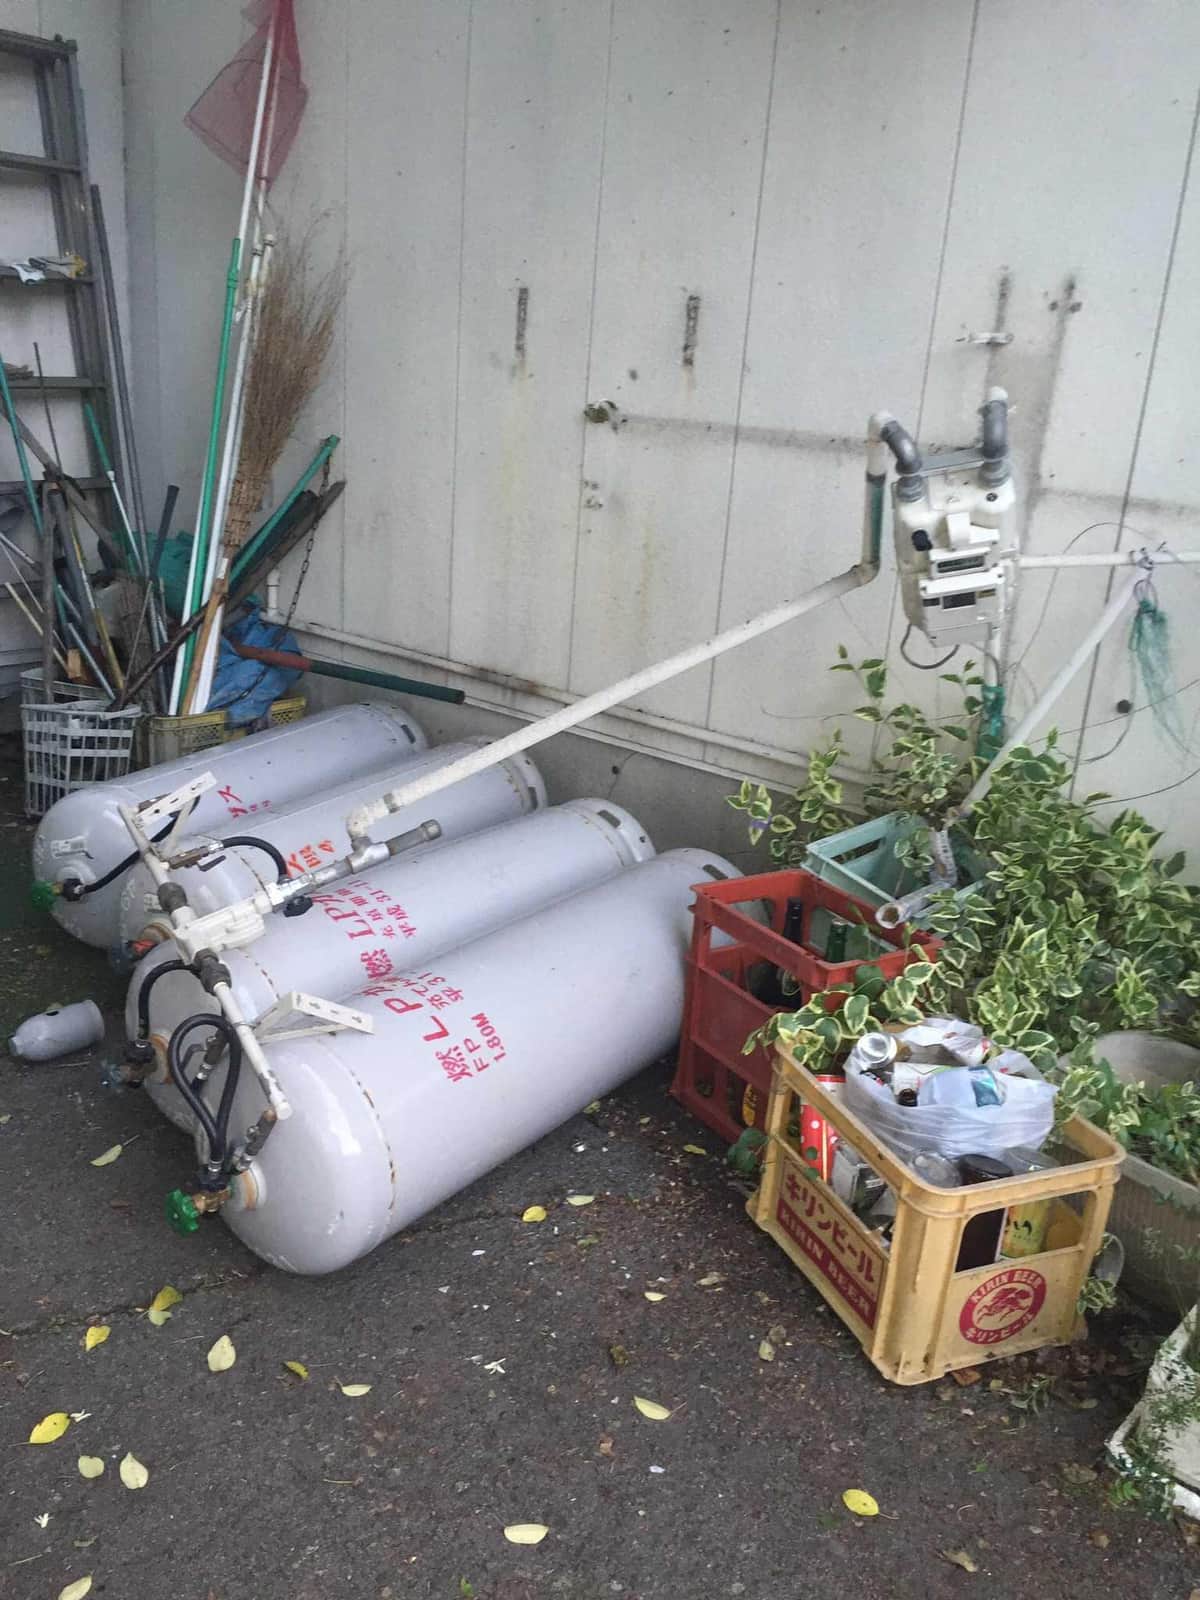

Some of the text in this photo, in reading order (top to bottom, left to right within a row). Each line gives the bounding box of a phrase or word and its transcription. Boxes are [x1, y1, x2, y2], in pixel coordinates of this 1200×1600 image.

[785, 1173, 875, 1283] キリンビール
[970, 1270, 1043, 1304] KIRIN BEER
